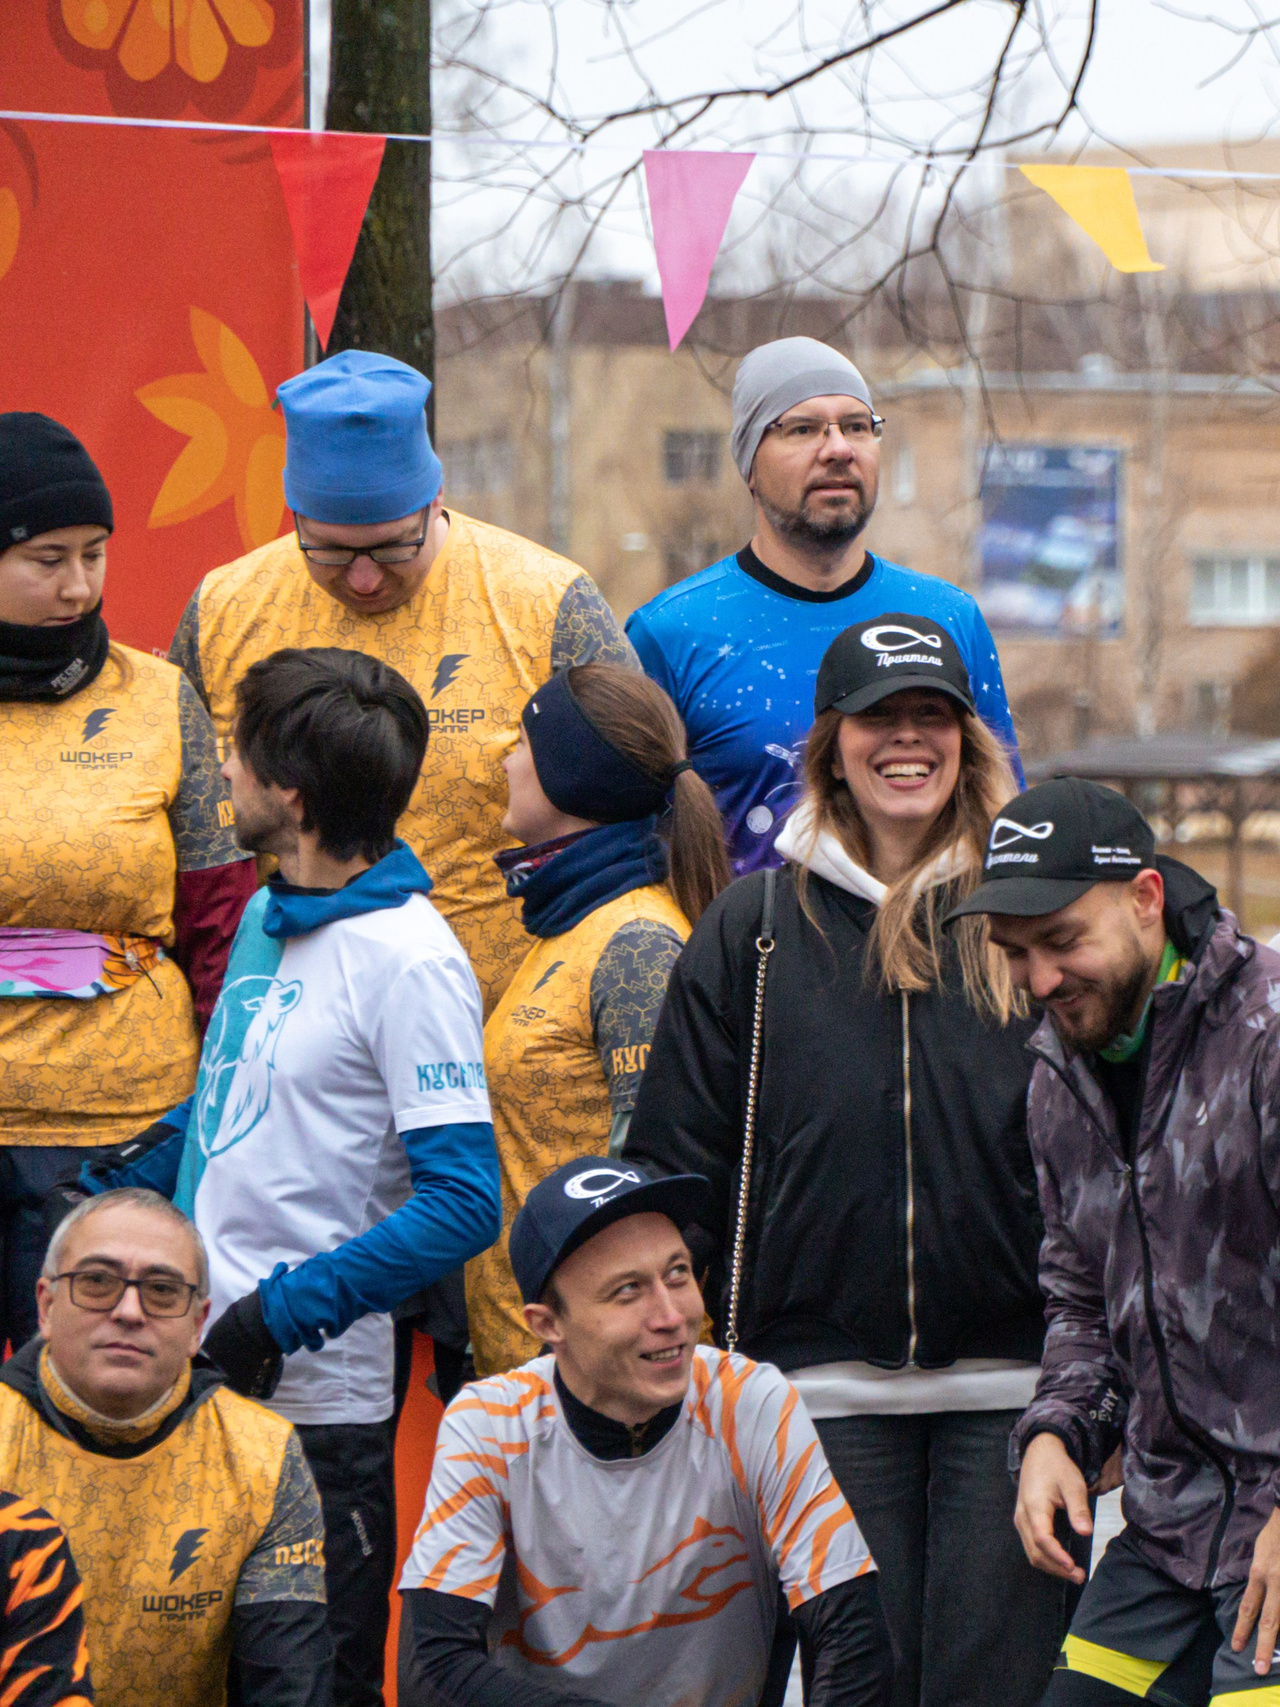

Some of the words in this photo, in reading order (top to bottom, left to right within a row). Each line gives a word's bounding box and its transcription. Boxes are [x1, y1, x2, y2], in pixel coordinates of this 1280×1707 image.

[875, 652, 943, 668] Приятели
[427, 708, 485, 724] ОКЕР
[430, 725, 468, 734] РУППА
[60, 751, 133, 763] ШОКЕР
[350, 1510, 373, 1556] Reebok
[142, 1590, 223, 1612] ШОКЕР
